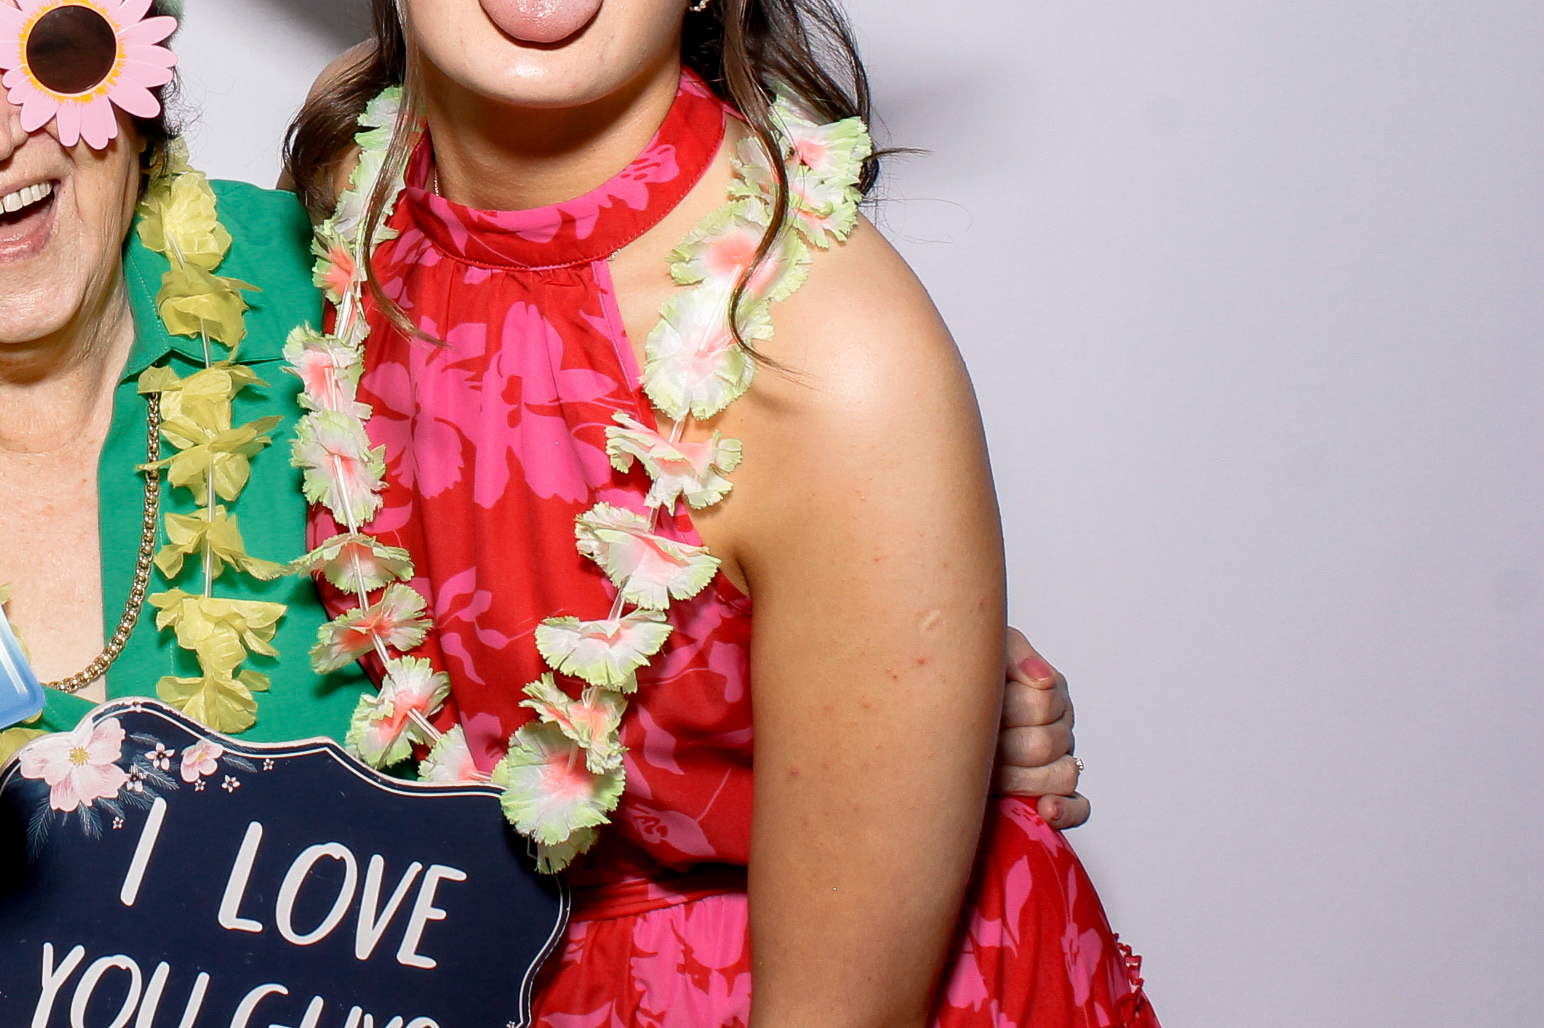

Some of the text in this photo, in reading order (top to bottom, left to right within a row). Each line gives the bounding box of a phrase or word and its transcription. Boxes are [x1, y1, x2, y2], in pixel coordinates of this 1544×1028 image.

[119, 797, 467, 969] I LOVE
[31, 941, 211, 1028] YOU
